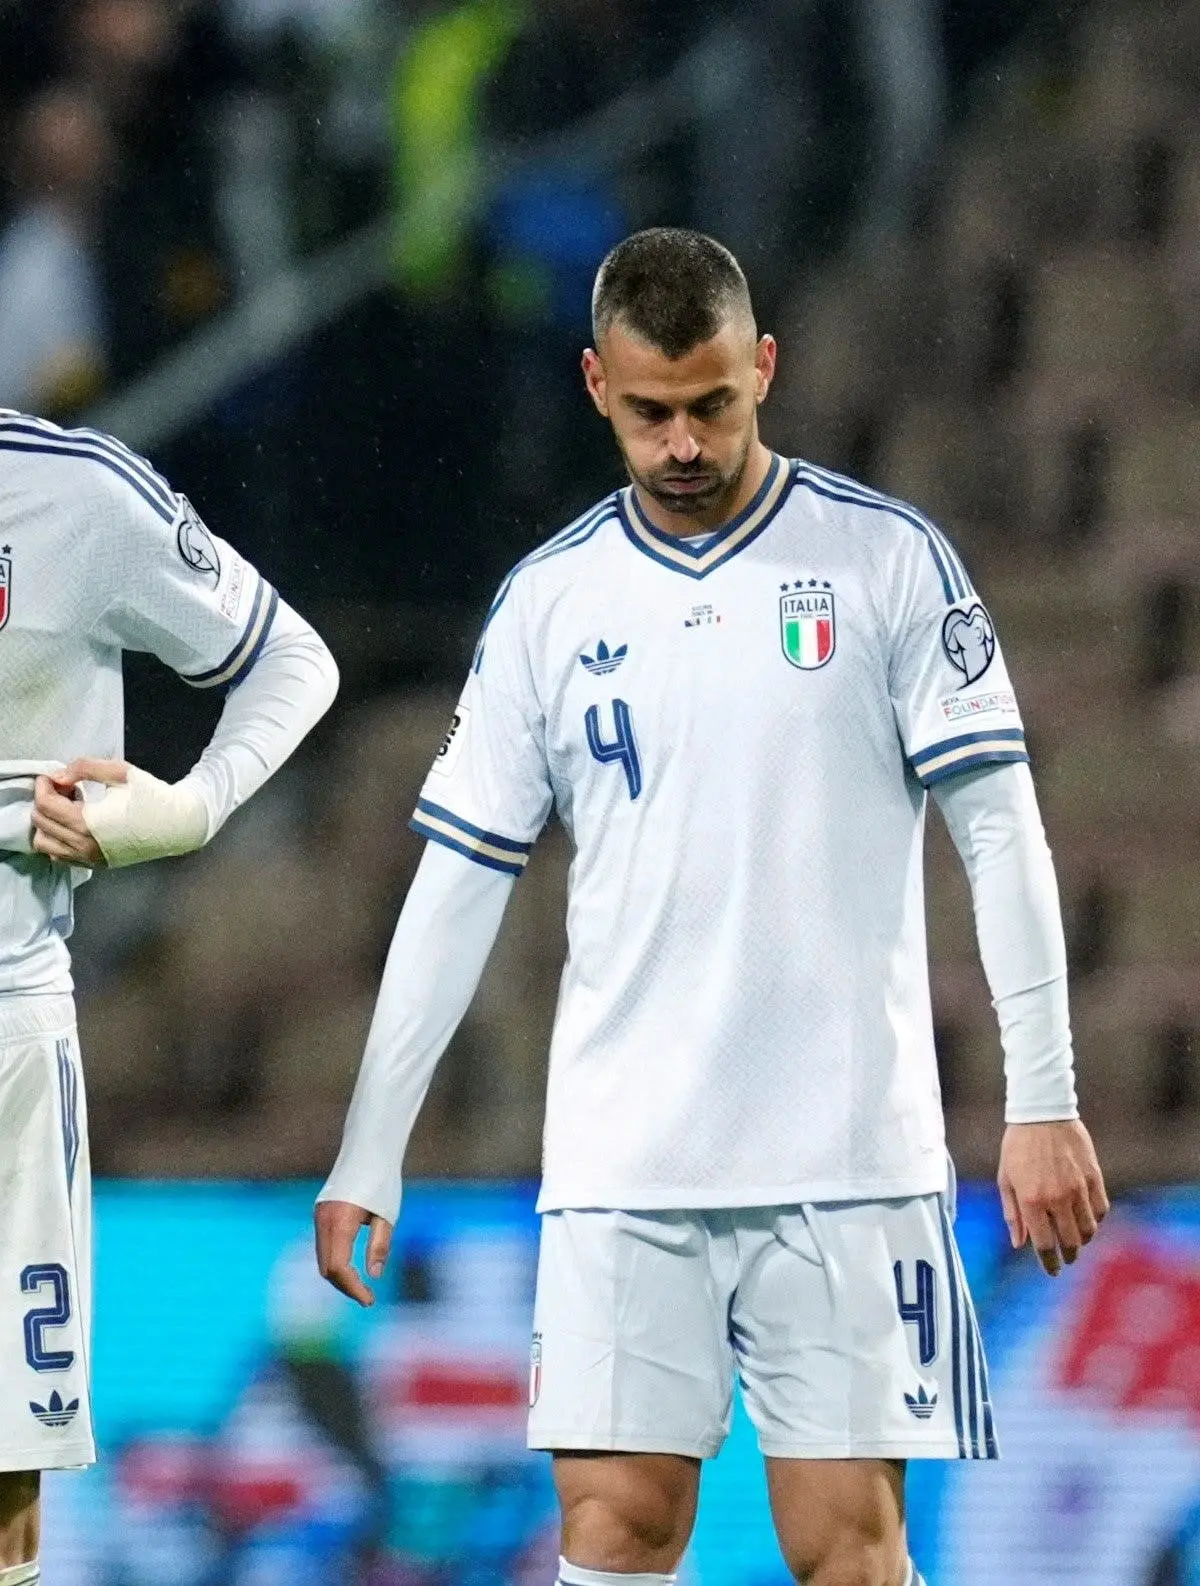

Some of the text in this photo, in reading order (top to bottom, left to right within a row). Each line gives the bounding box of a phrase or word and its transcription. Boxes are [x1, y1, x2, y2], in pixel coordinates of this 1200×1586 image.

[784, 598, 829, 613] ITALIA
[584, 698, 643, 801] 4
[20, 1263, 76, 1373] 2
[893, 1259, 939, 1367] 4
